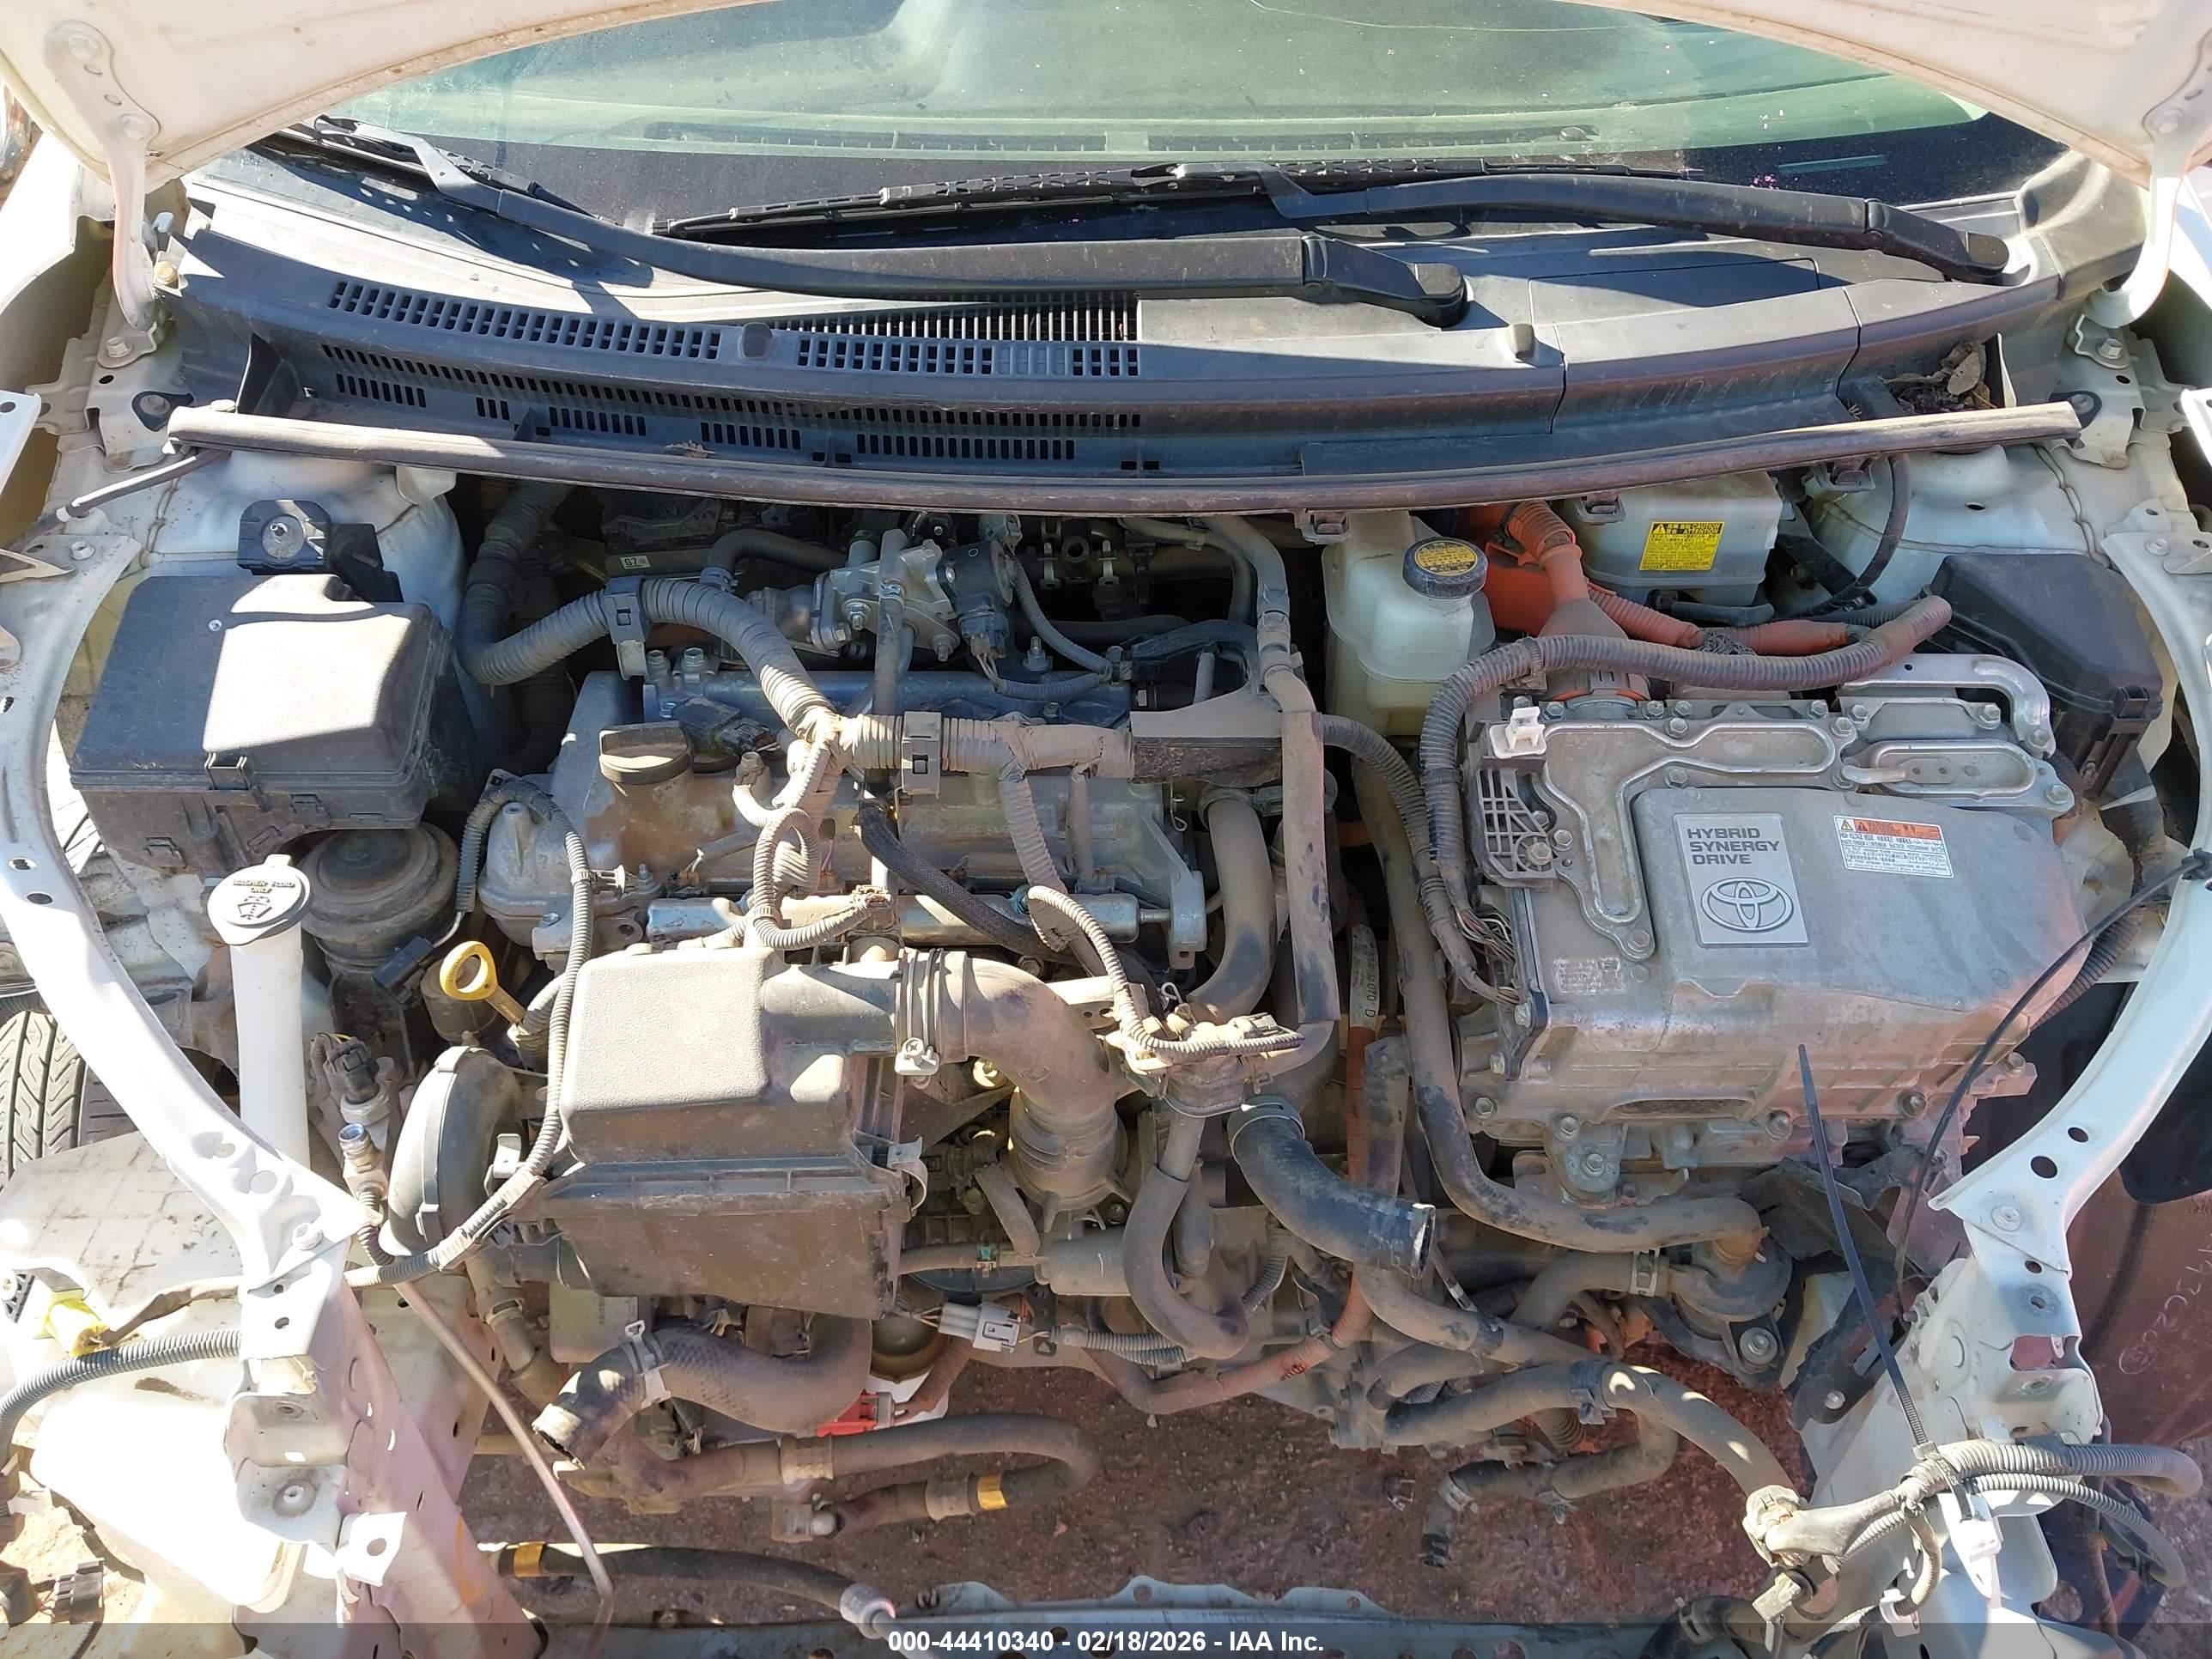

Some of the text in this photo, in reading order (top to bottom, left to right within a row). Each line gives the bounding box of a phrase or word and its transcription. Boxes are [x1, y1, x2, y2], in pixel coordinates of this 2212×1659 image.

[1686, 828, 1760, 839] HYBRID
[1689, 841, 1780, 852] SYNERGY
[1692, 854, 1753, 865] DRIVE
